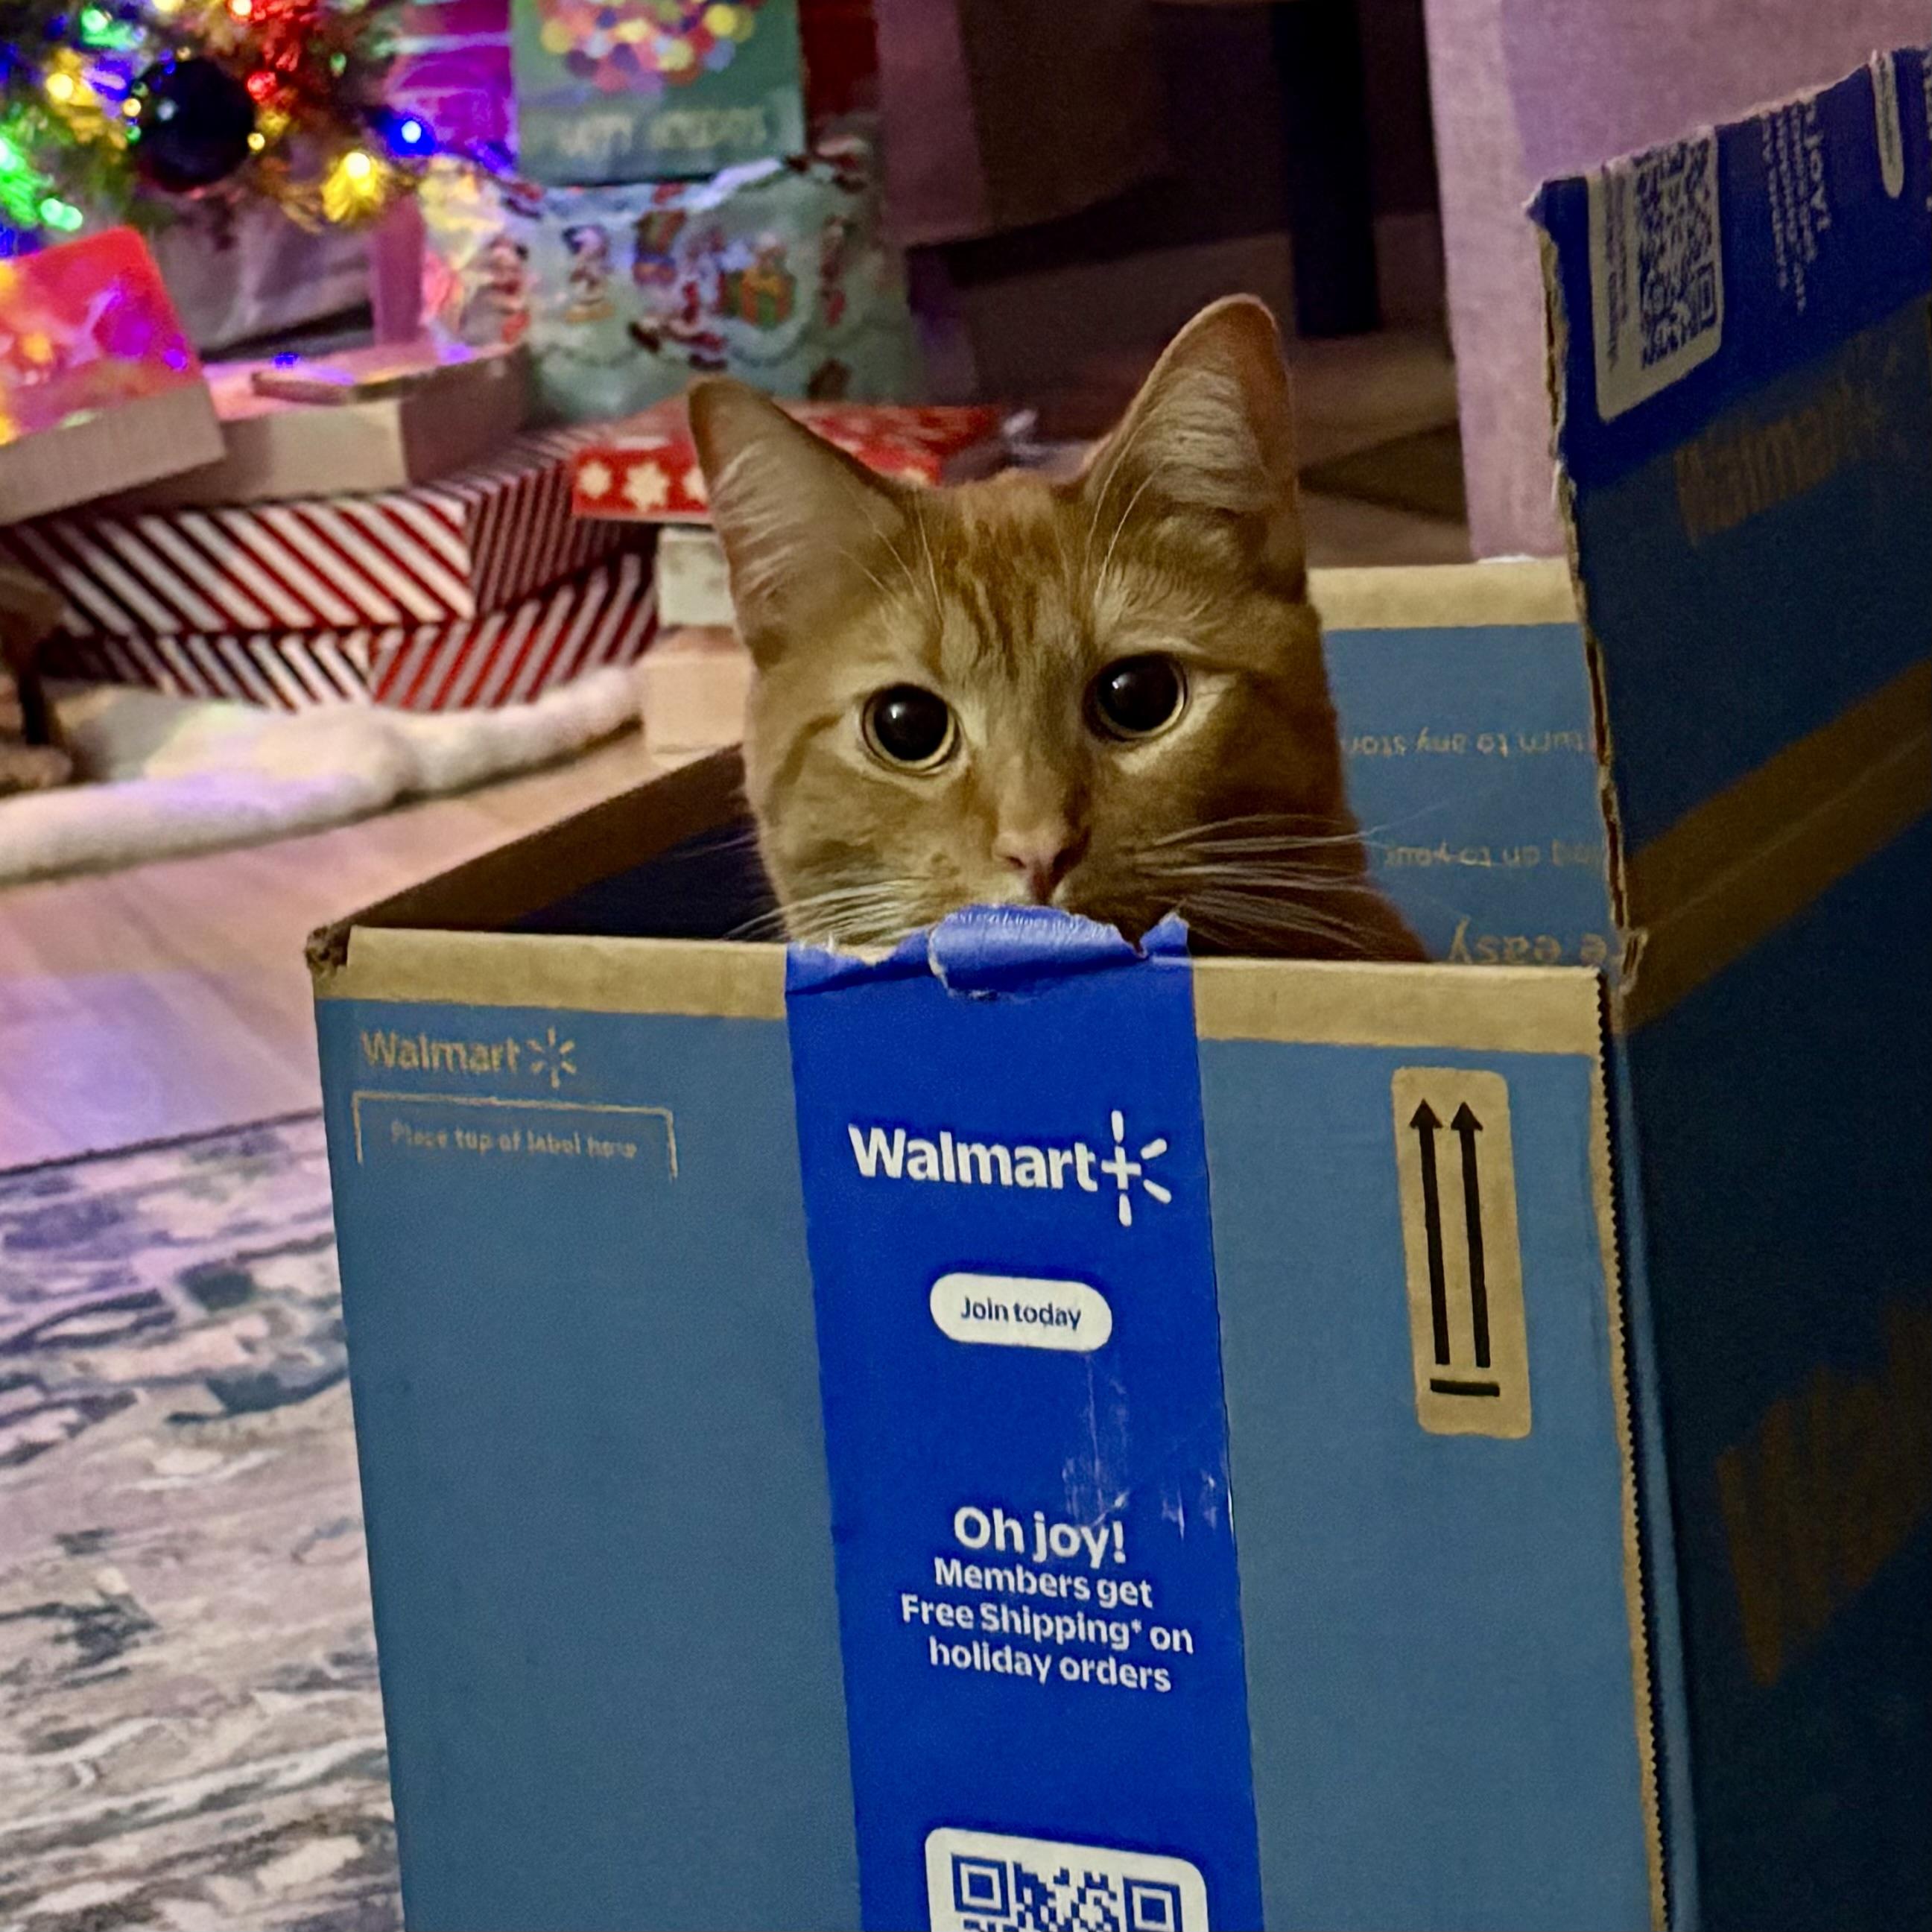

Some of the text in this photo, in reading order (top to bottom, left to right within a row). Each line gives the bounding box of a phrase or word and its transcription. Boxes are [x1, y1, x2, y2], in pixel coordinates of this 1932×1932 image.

[1415, 726, 1468, 756] any
[1477, 732, 1510, 758] to
[1448, 916, 1562, 965] easy
[360, 1030, 521, 1074] Walmart
[454, 1127, 492, 1153] top
[498, 1128, 521, 1152] of
[527, 1130, 581, 1155] label
[960, 1295, 1081, 1331] Join today
[954, 1506, 1126, 1569] Oh joy!
[934, 1557, 1153, 1609] Members get
[901, 1593, 974, 1629] Free
[1150, 1627, 1194, 1654] on
[929, 1635, 1171, 1692] holiday orders
